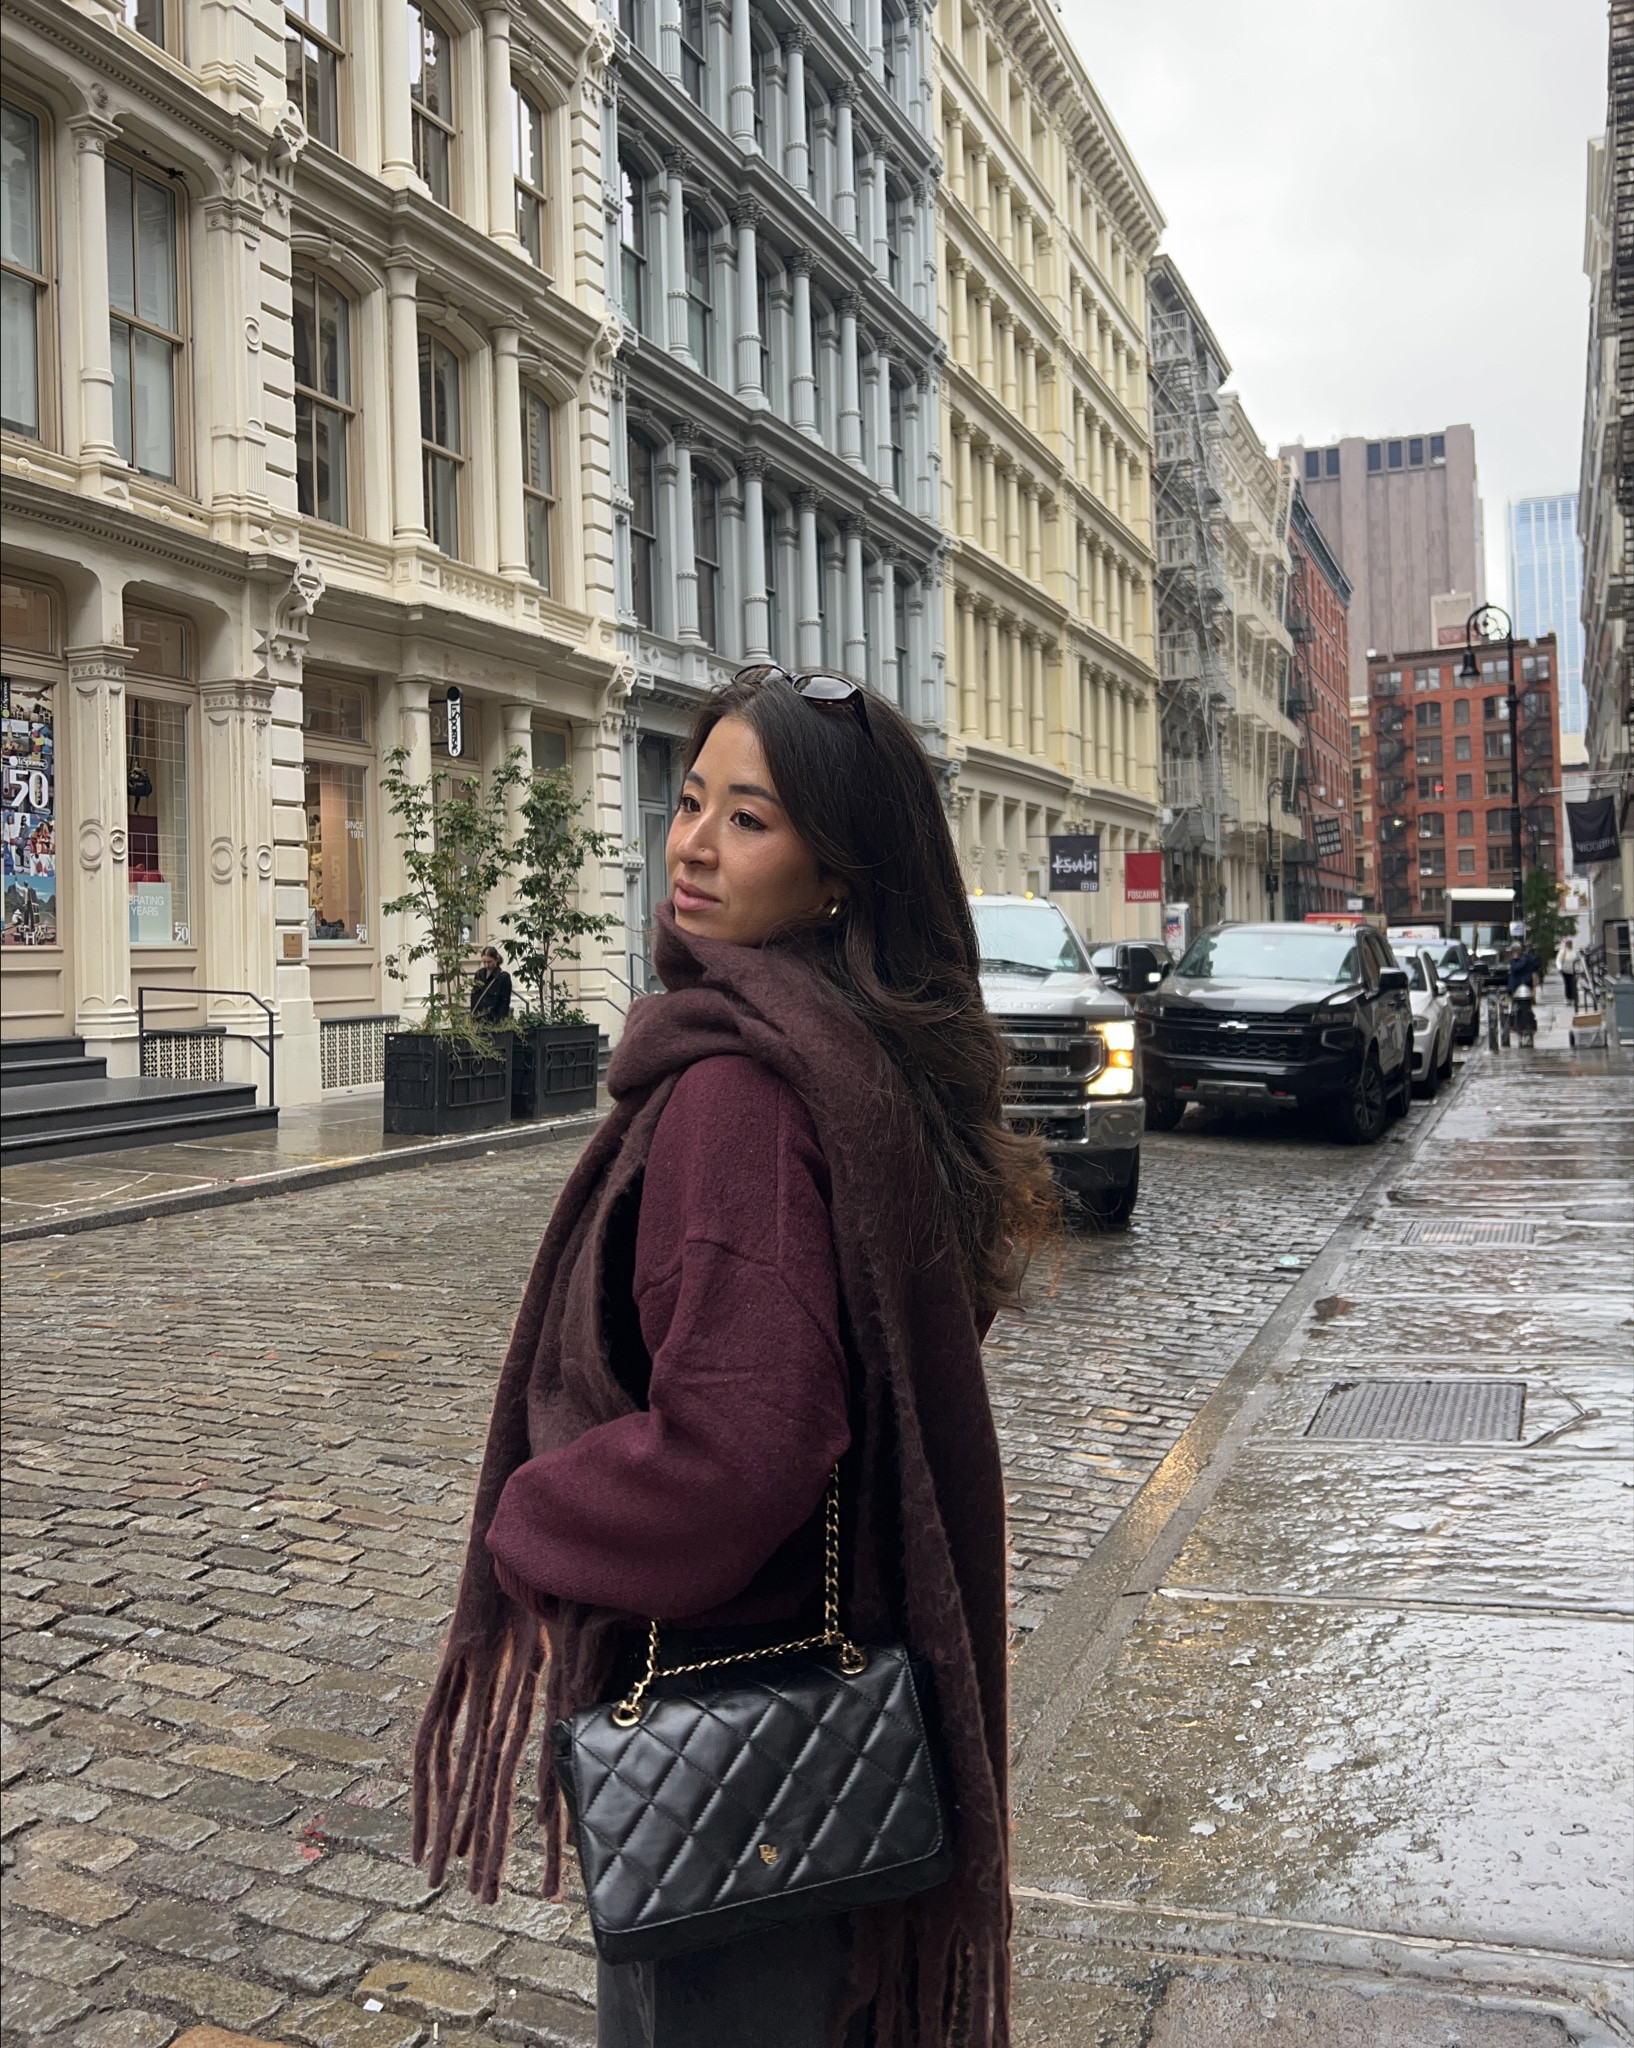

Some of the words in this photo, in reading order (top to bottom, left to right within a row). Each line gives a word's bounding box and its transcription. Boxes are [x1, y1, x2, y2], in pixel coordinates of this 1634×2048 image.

[10, 770, 48, 808] 50
[345, 820, 364, 829] SINCE
[350, 830, 364, 839] 1974
[1052, 853, 1097, 874] ksubi
[1127, 890, 1159, 900] FOSCARINI
[131, 906, 159, 916] YEARS
[174, 927, 189, 941] 50
[356, 929, 367, 941] 50
